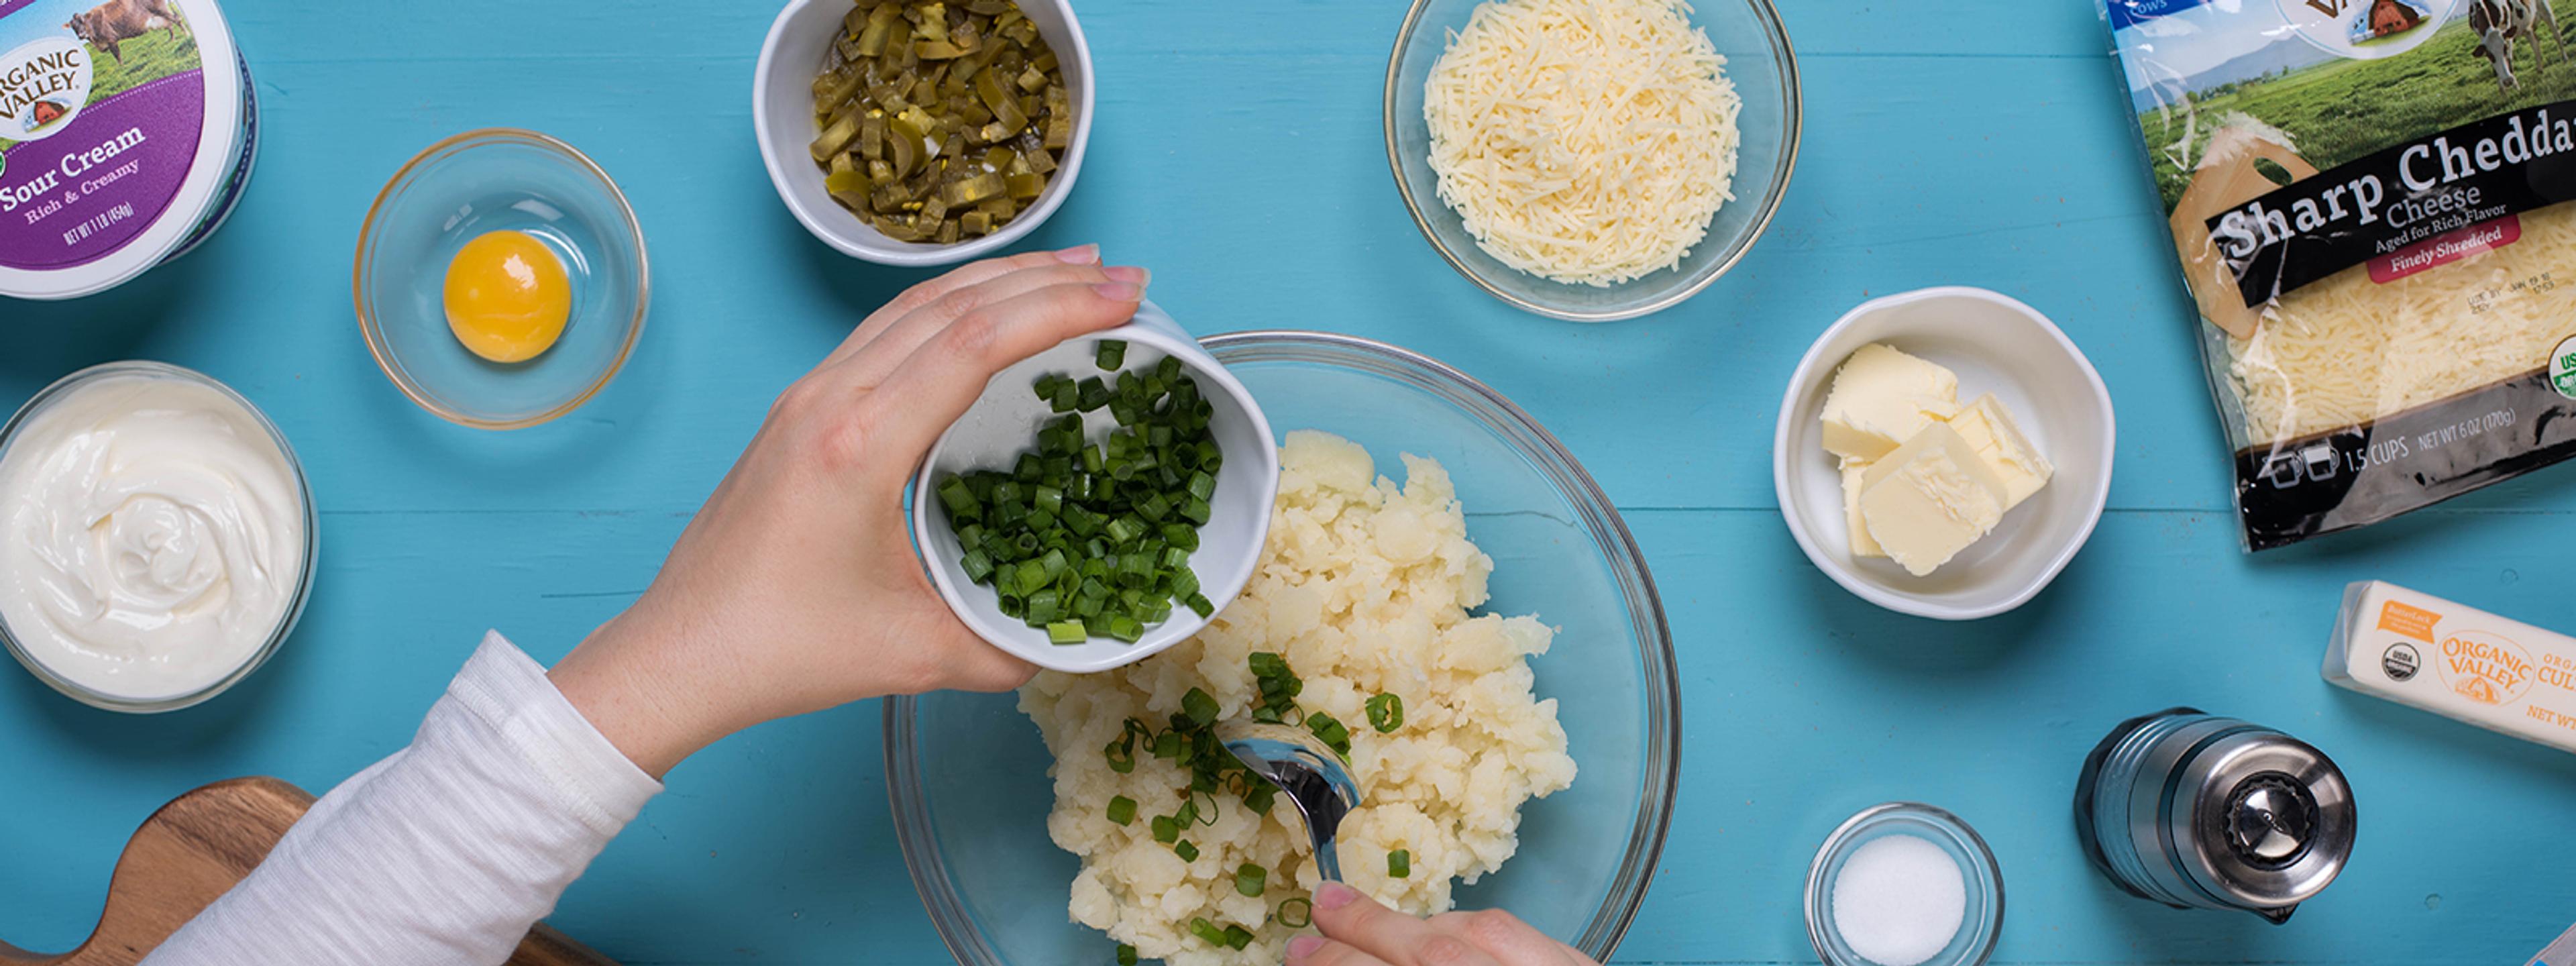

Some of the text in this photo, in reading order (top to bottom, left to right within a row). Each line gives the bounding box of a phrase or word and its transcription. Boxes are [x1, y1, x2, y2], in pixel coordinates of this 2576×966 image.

[0, 127, 146, 212] Sour Cream
[24, 160, 139, 225] Rich & Creamy
[2387, 186, 2481, 228] Cheese
[62, 228, 80, 246] NET
[77, 222, 93, 239] WT
[90, 219, 98, 231] 1
[96, 213, 109, 229] LB
[2220, 174, 2384, 258] Sharp
[2375, 204, 2507, 254] Aged for Rich Flavor
[2390, 225, 2502, 272] Finely Shredded
[2418, 407, 2516, 451] NET WT 6 OZ (170g)
[2345, 436, 2410, 472] 1.5 CUPS
[2443, 637, 2533, 680] ORGANIC
[2449, 657, 2520, 690] VALLEY
[2538, 665, 2576, 691] CUL
[2526, 704, 2576, 731] NET WT
